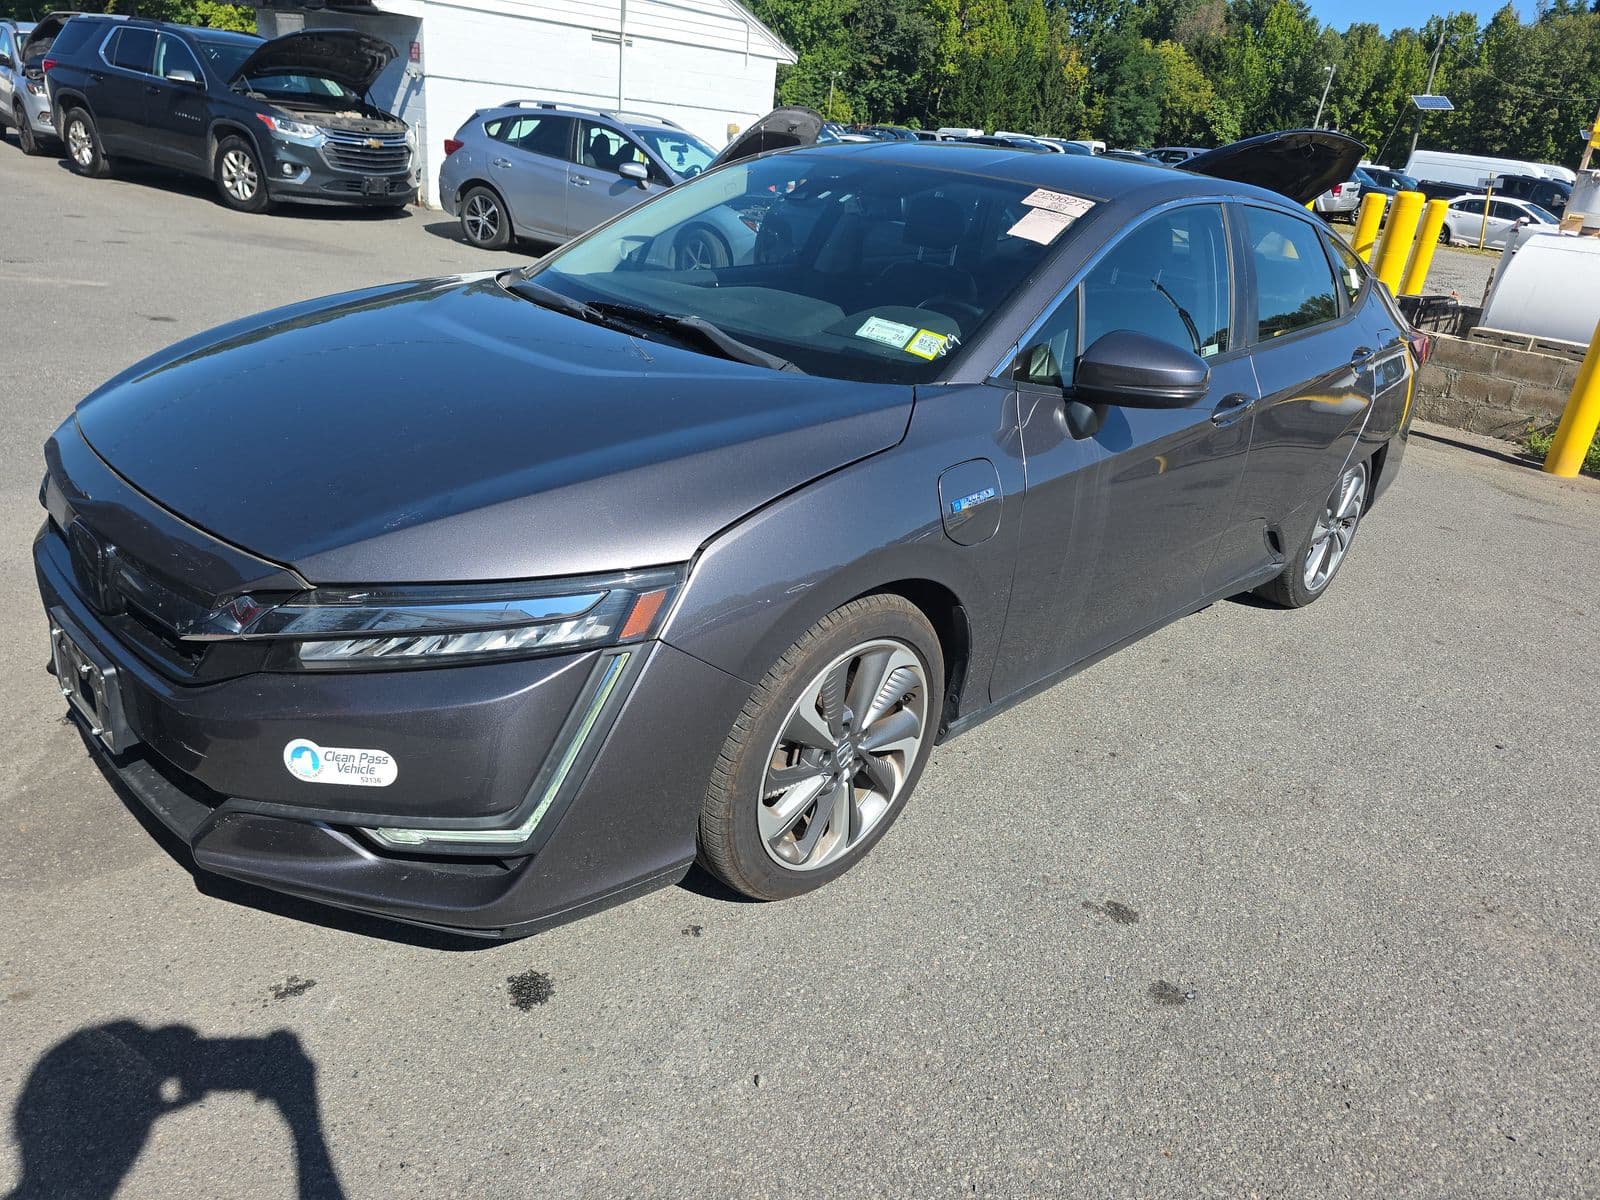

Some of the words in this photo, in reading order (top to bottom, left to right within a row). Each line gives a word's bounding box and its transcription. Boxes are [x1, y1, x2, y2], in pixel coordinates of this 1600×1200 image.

[324, 751, 355, 763] Clean
[358, 752, 389, 765] Pass
[337, 762, 376, 775] Vehicle
